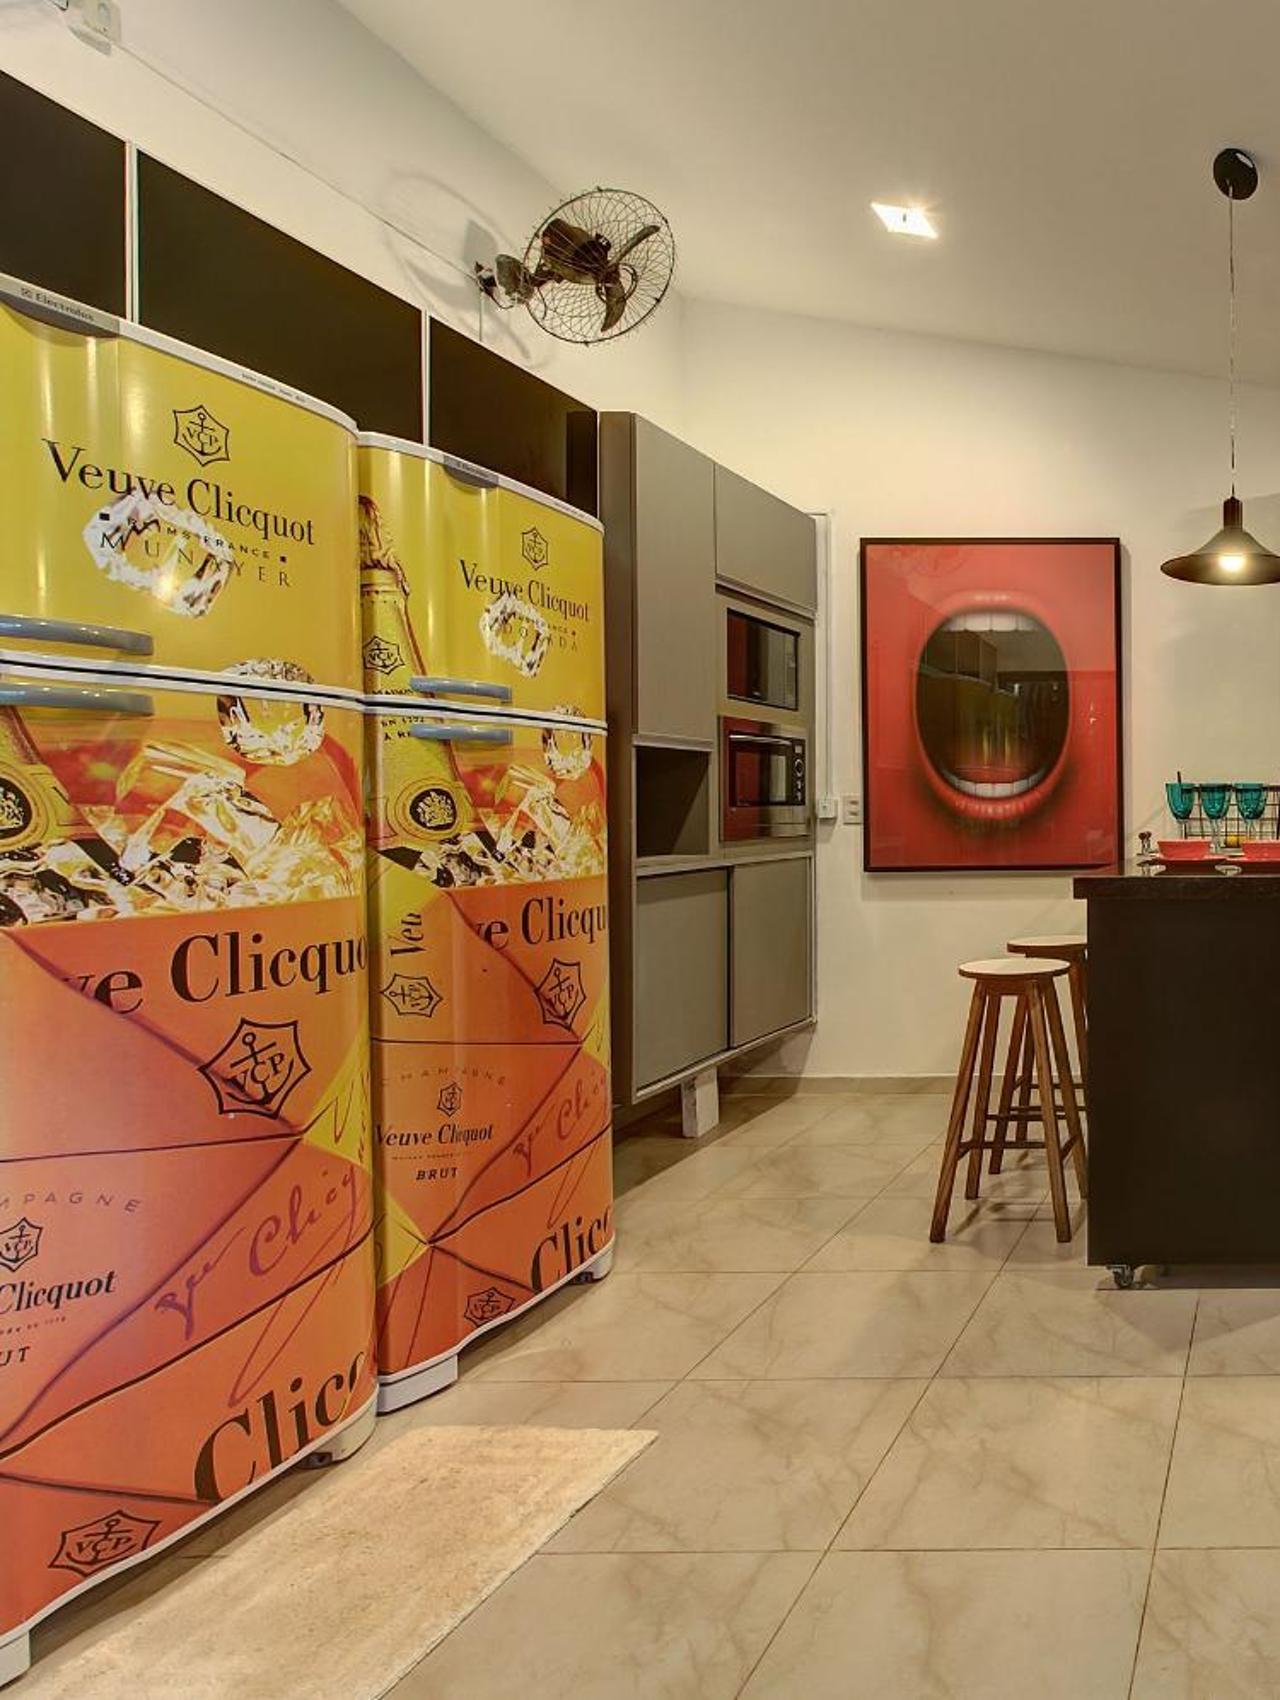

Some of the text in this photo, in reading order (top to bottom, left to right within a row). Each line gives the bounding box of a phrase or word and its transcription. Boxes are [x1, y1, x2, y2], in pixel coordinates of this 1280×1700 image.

[42, 438, 315, 546] Veuve Clicquot
[459, 559, 590, 622] Veuve Clicquot
[224, 1052, 286, 1093] VCP
[376, 1124, 433, 1147] Veuve
[415, 1166, 459, 1181] BRUT
